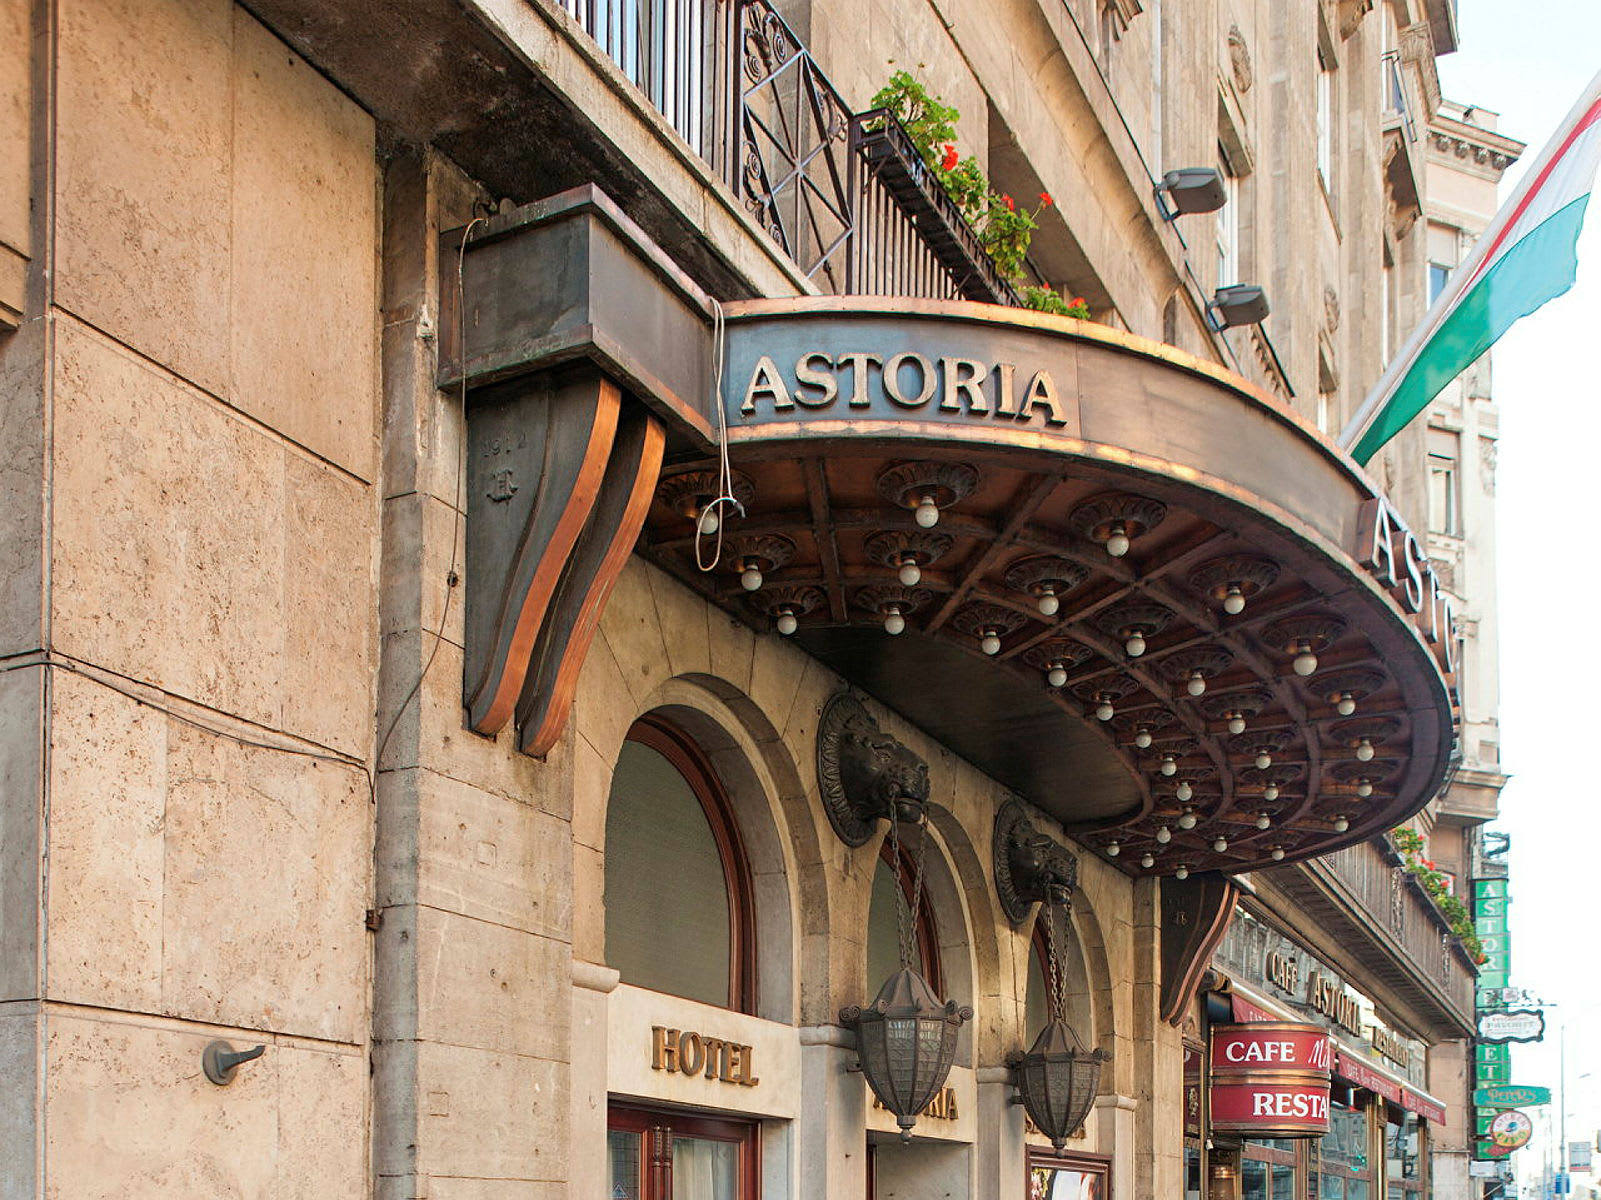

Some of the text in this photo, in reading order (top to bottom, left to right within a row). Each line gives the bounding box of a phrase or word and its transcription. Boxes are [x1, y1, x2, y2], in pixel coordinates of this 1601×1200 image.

[740, 351, 1068, 427] ASTORIA
[1306, 971, 1361, 1038] ASTORIA
[651, 1025, 759, 1087] HOTEL
[1226, 1041, 1296, 1063] CAFE
[1252, 1092, 1329, 1119] RESTA
